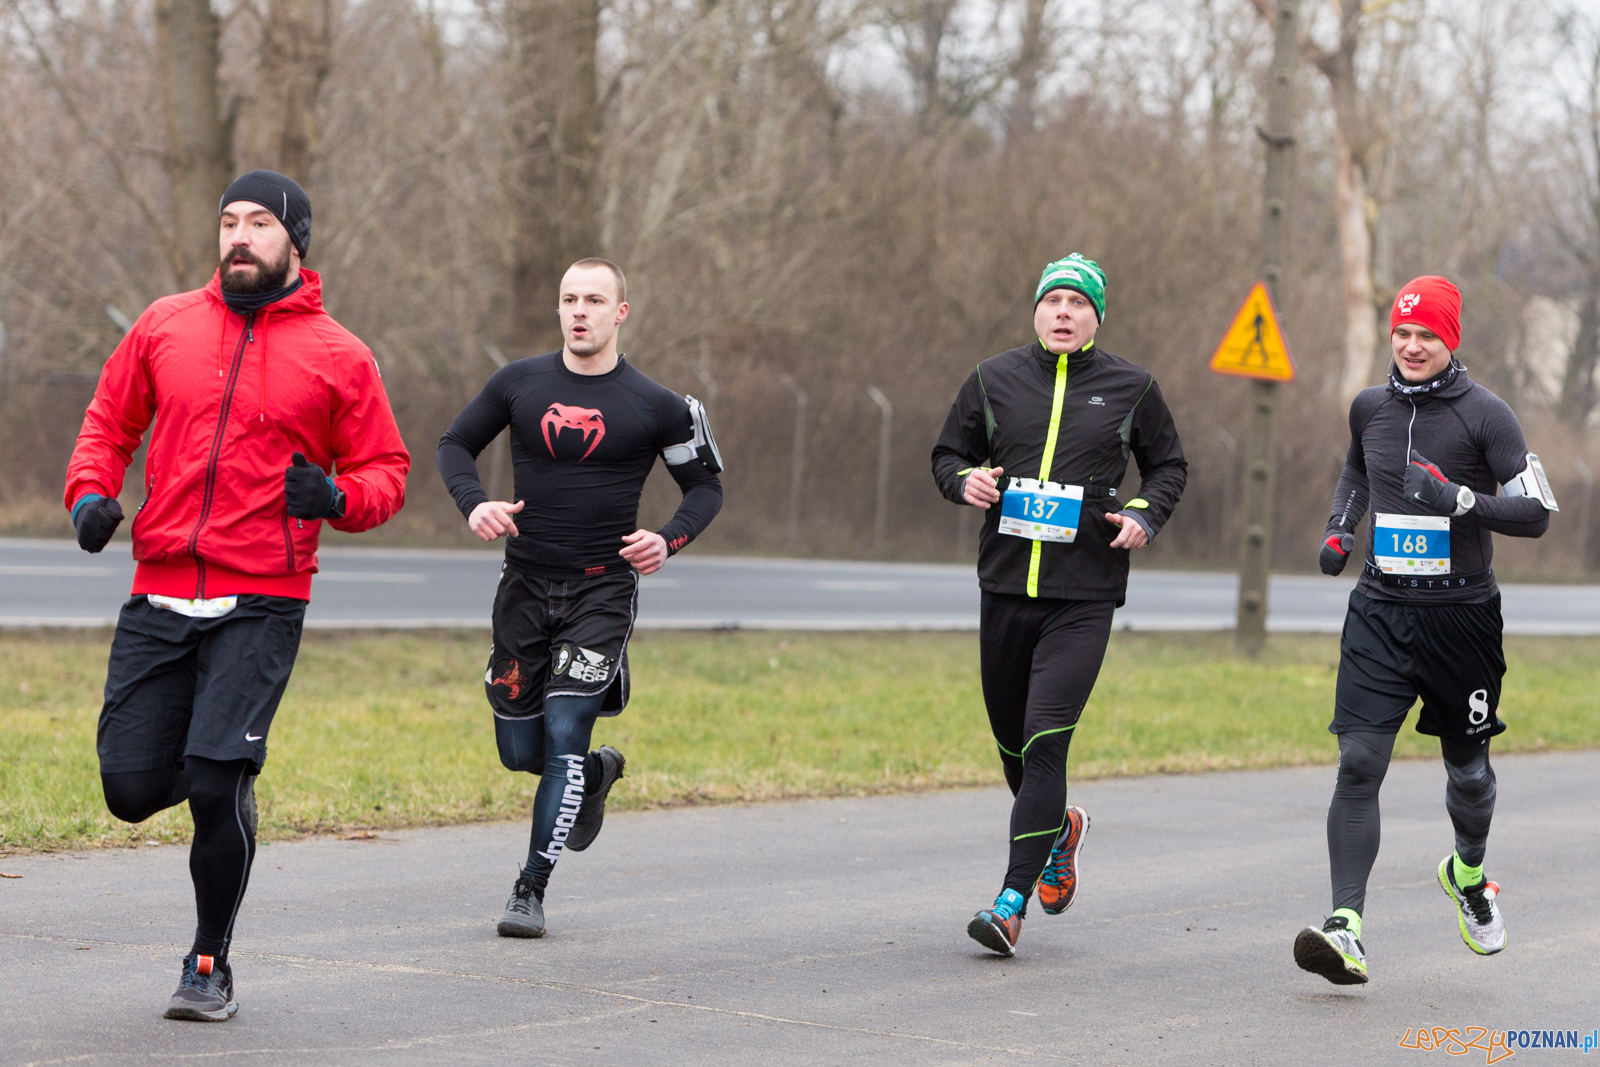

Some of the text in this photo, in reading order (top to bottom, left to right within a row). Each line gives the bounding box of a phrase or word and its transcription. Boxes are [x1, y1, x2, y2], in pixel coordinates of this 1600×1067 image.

[1023, 497, 1059, 520] 137
[1391, 533, 1428, 554] 168
[1469, 689, 1489, 724] 8
